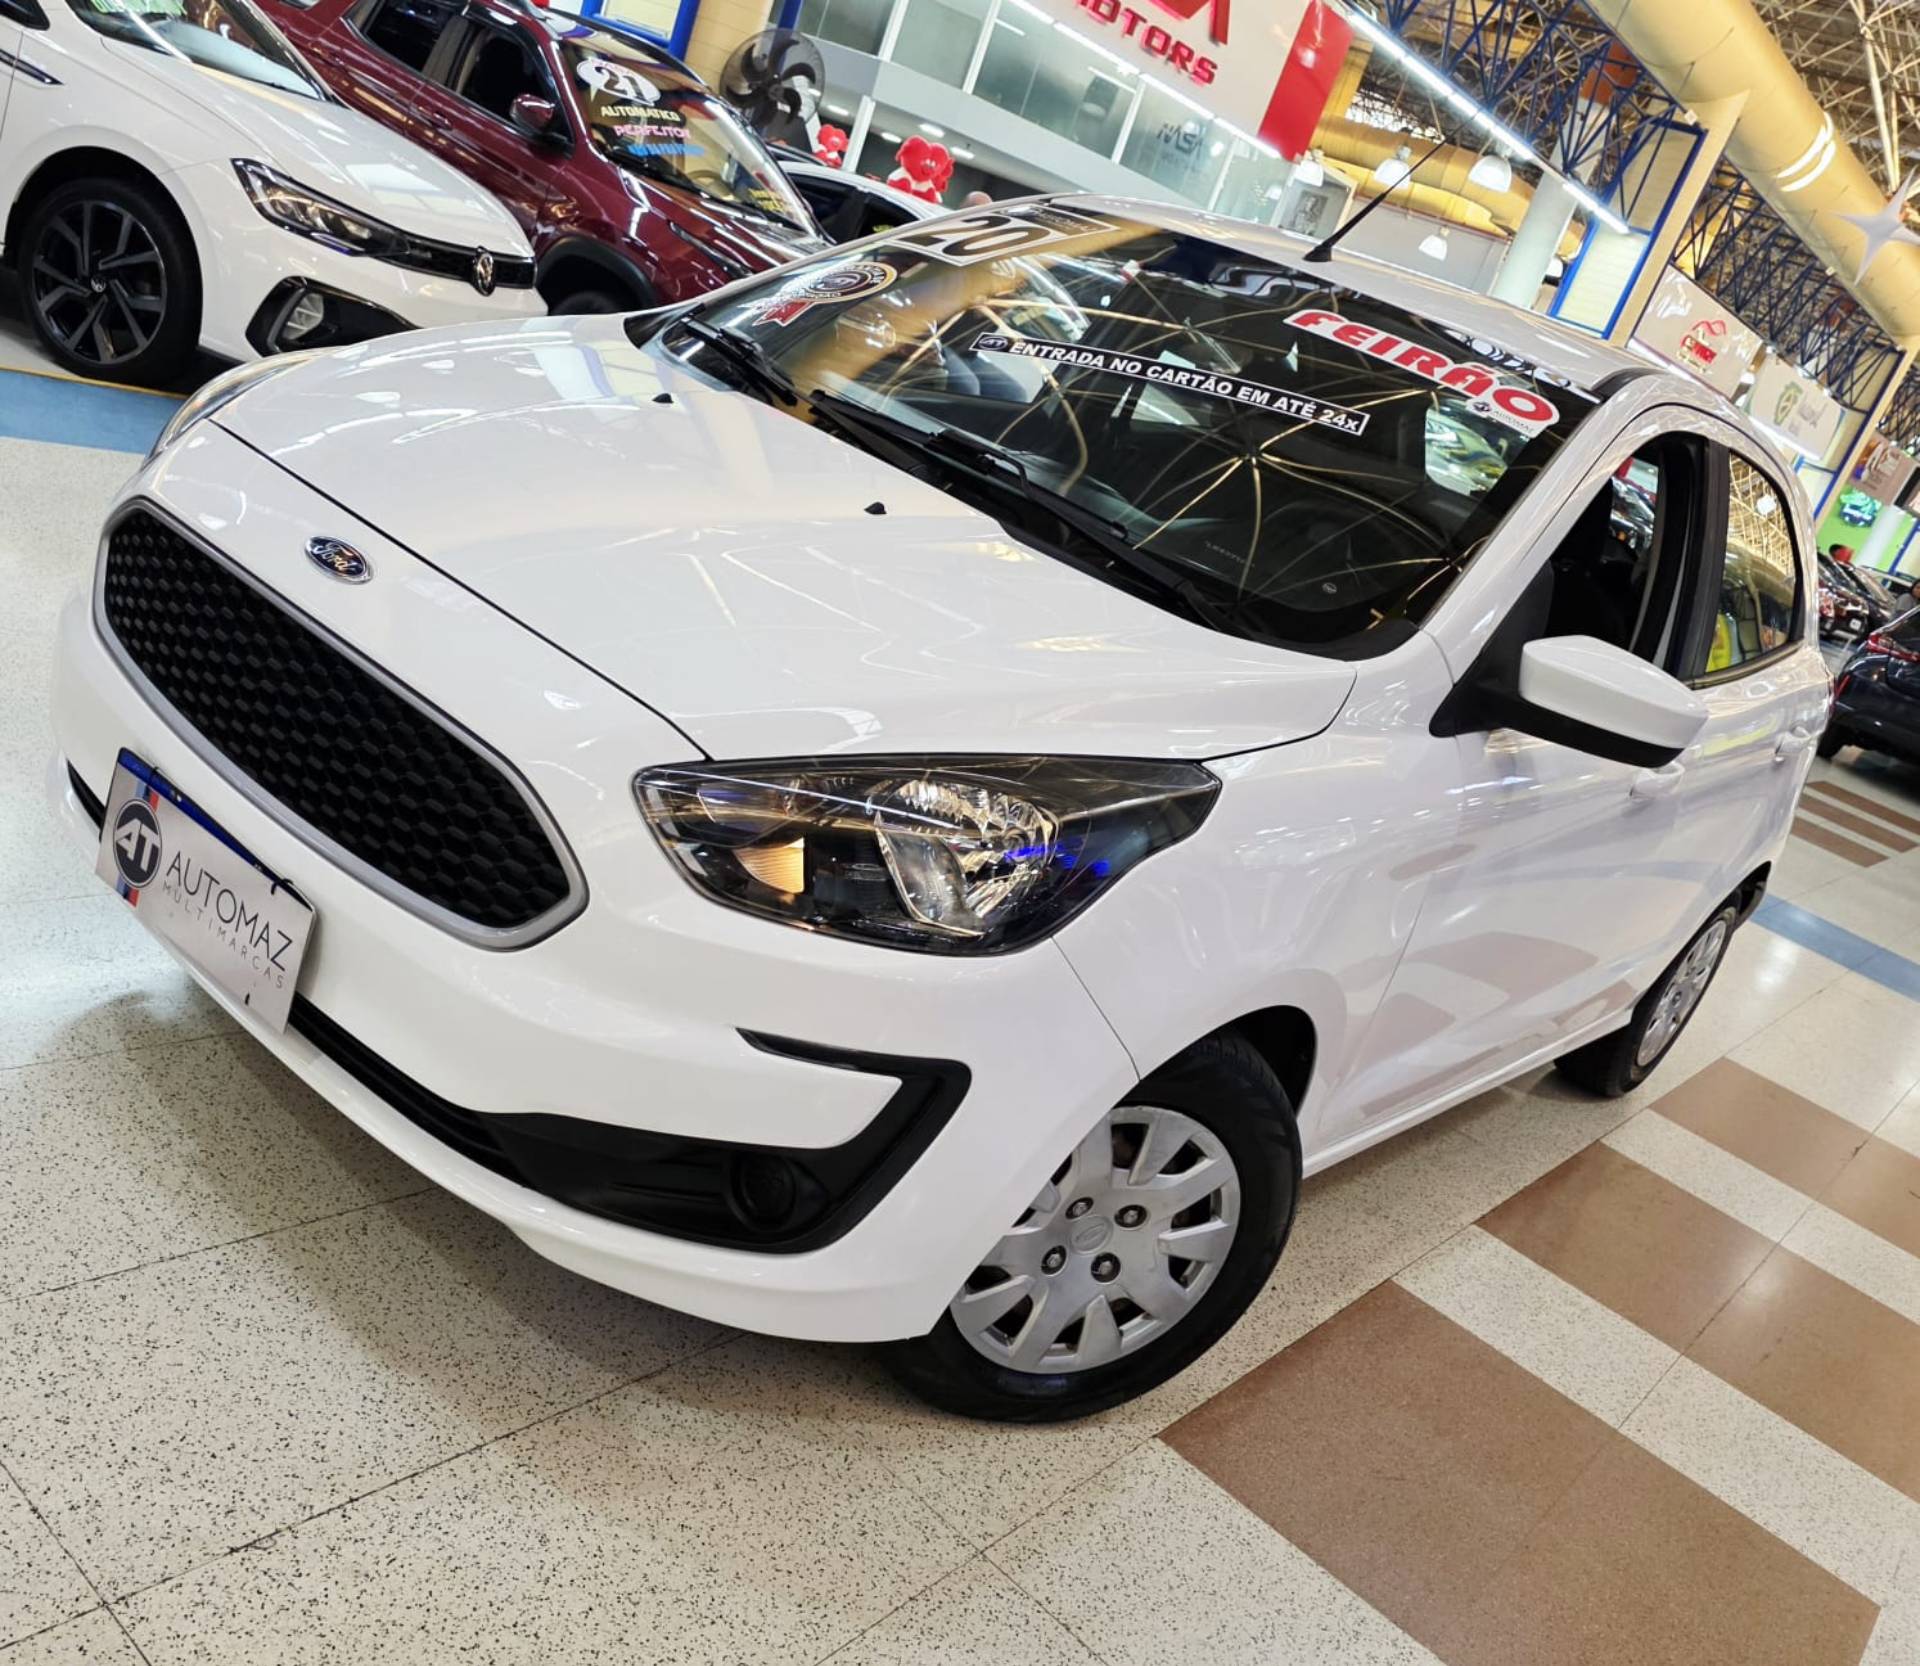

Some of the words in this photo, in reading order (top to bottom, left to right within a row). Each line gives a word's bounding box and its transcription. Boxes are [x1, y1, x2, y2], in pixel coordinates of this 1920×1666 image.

[594, 66, 648, 102] 21
[1079, 0, 1218, 85] OTORS
[897, 215, 1052, 257] 20
[1008, 341, 1105, 368] ENTRADA
[1109, 357, 1142, 375] NO
[1146, 364, 1233, 396] CARTÃO
[1236, 386, 1271, 406] EM
[1272, 396, 1317, 418] ATÉ
[1317, 408, 1360, 432] 24x
[1294, 311, 1554, 422] FEIRÃO
[312, 541, 358, 572] Ford
[115, 816, 159, 875] AT
[166, 850, 294, 973] AUTOMAZ
[163, 881, 285, 990] MULTIMARCAS
